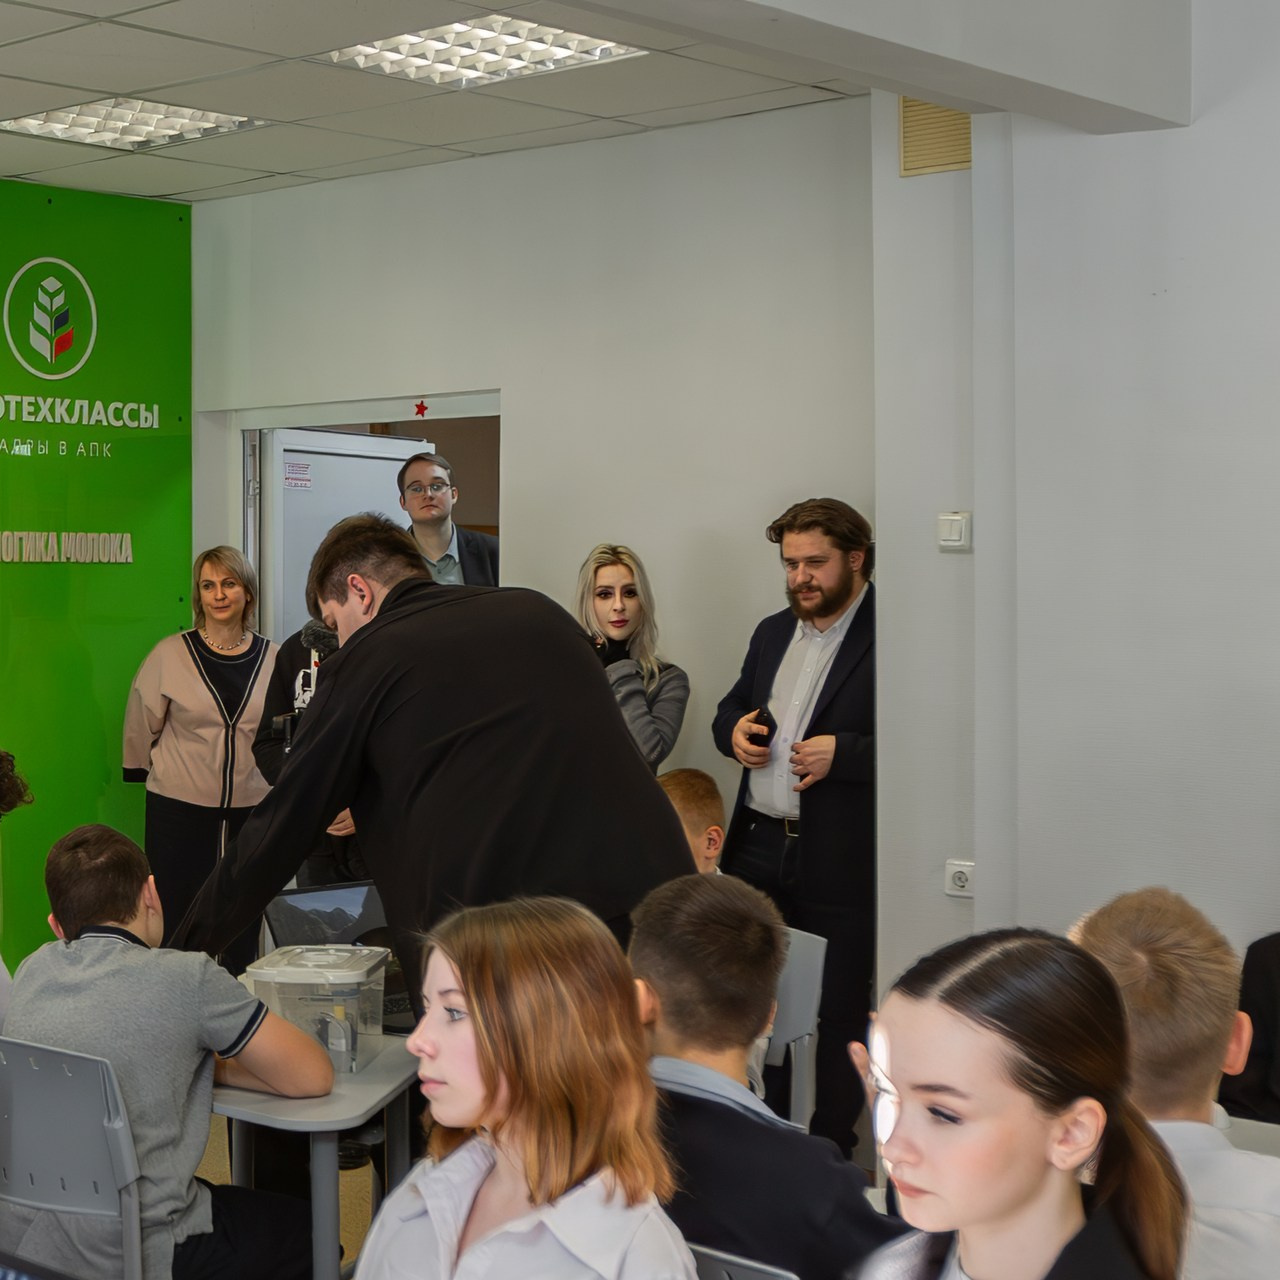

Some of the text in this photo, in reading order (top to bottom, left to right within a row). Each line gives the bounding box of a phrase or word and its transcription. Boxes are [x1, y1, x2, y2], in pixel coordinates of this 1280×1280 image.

[58, 440, 68, 456] В
[76, 441, 112, 458] АПК
[61, 532, 134, 564] МОЛОКА
